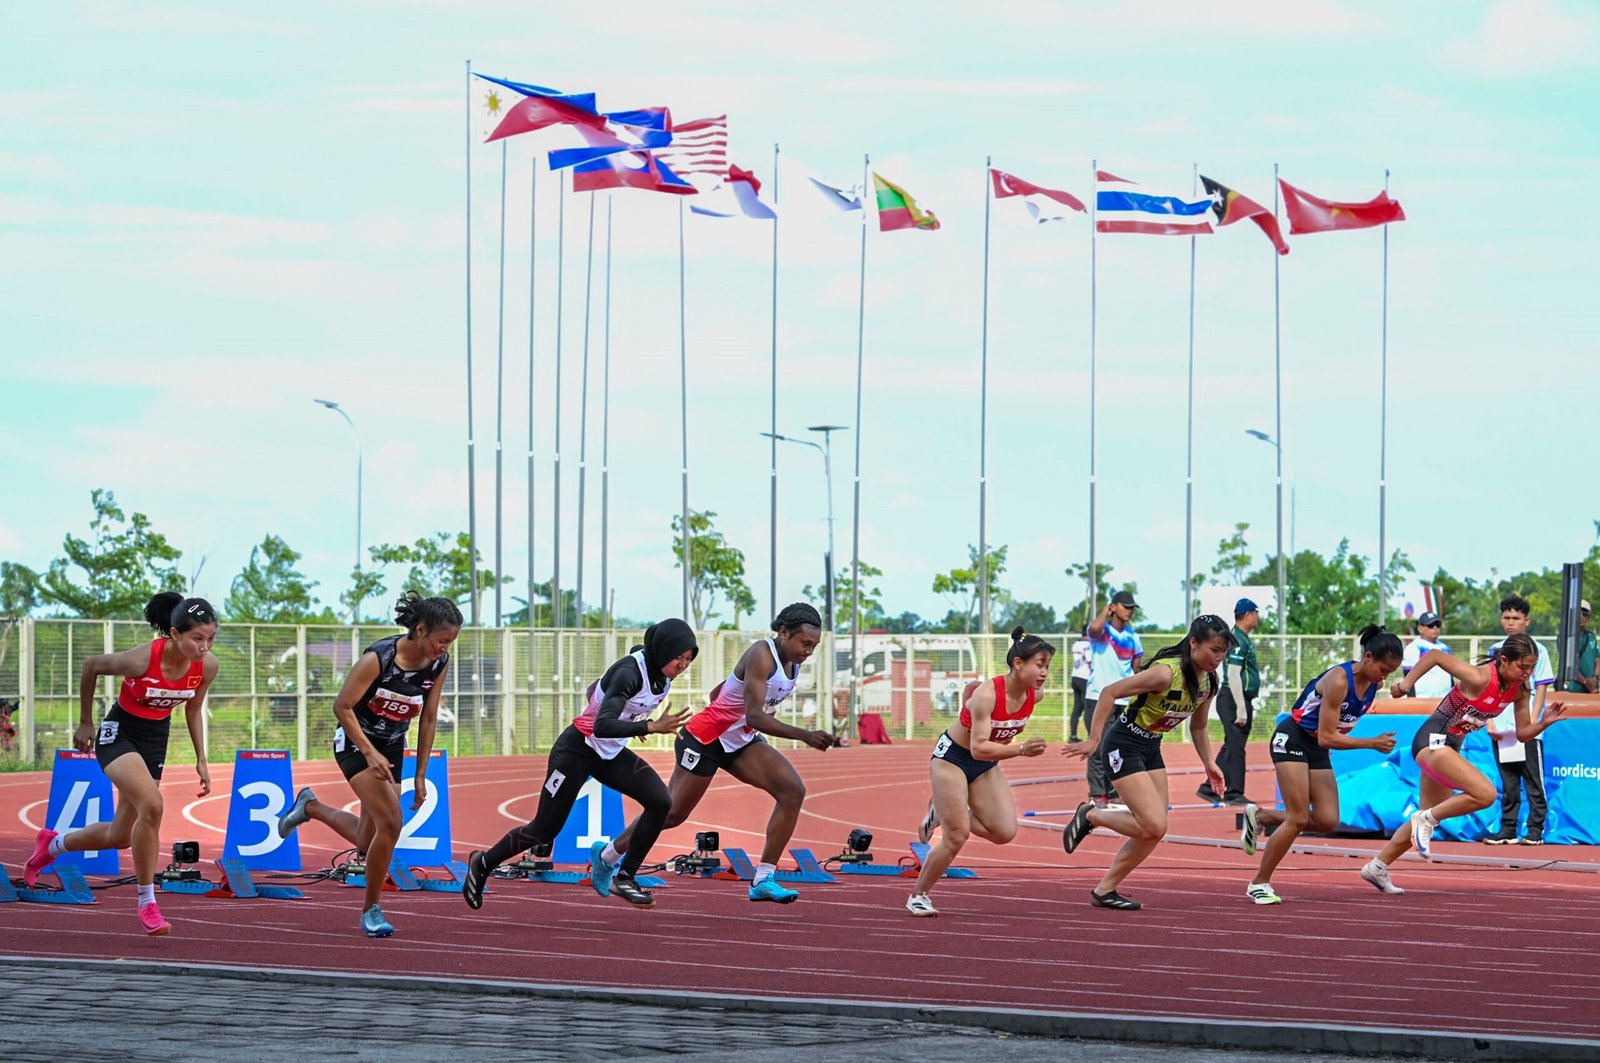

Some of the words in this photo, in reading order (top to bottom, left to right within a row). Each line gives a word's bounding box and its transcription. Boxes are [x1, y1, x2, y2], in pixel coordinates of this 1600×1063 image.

[148, 699, 183, 707] 207
[382, 700, 410, 714] 159
[1164, 718, 1180, 726] 79
[104, 728, 112, 738] 8
[995, 729, 1018, 738] 199
[1127, 723, 1150, 739] NIKE
[937, 742, 944, 752] 4
[1277, 738, 1283, 747] 2
[687, 753, 694, 763] 5
[395, 777, 439, 850] 2
[575, 775, 611, 848] 1
[54, 781, 100, 859] 4
[237, 780, 286, 857] 3
